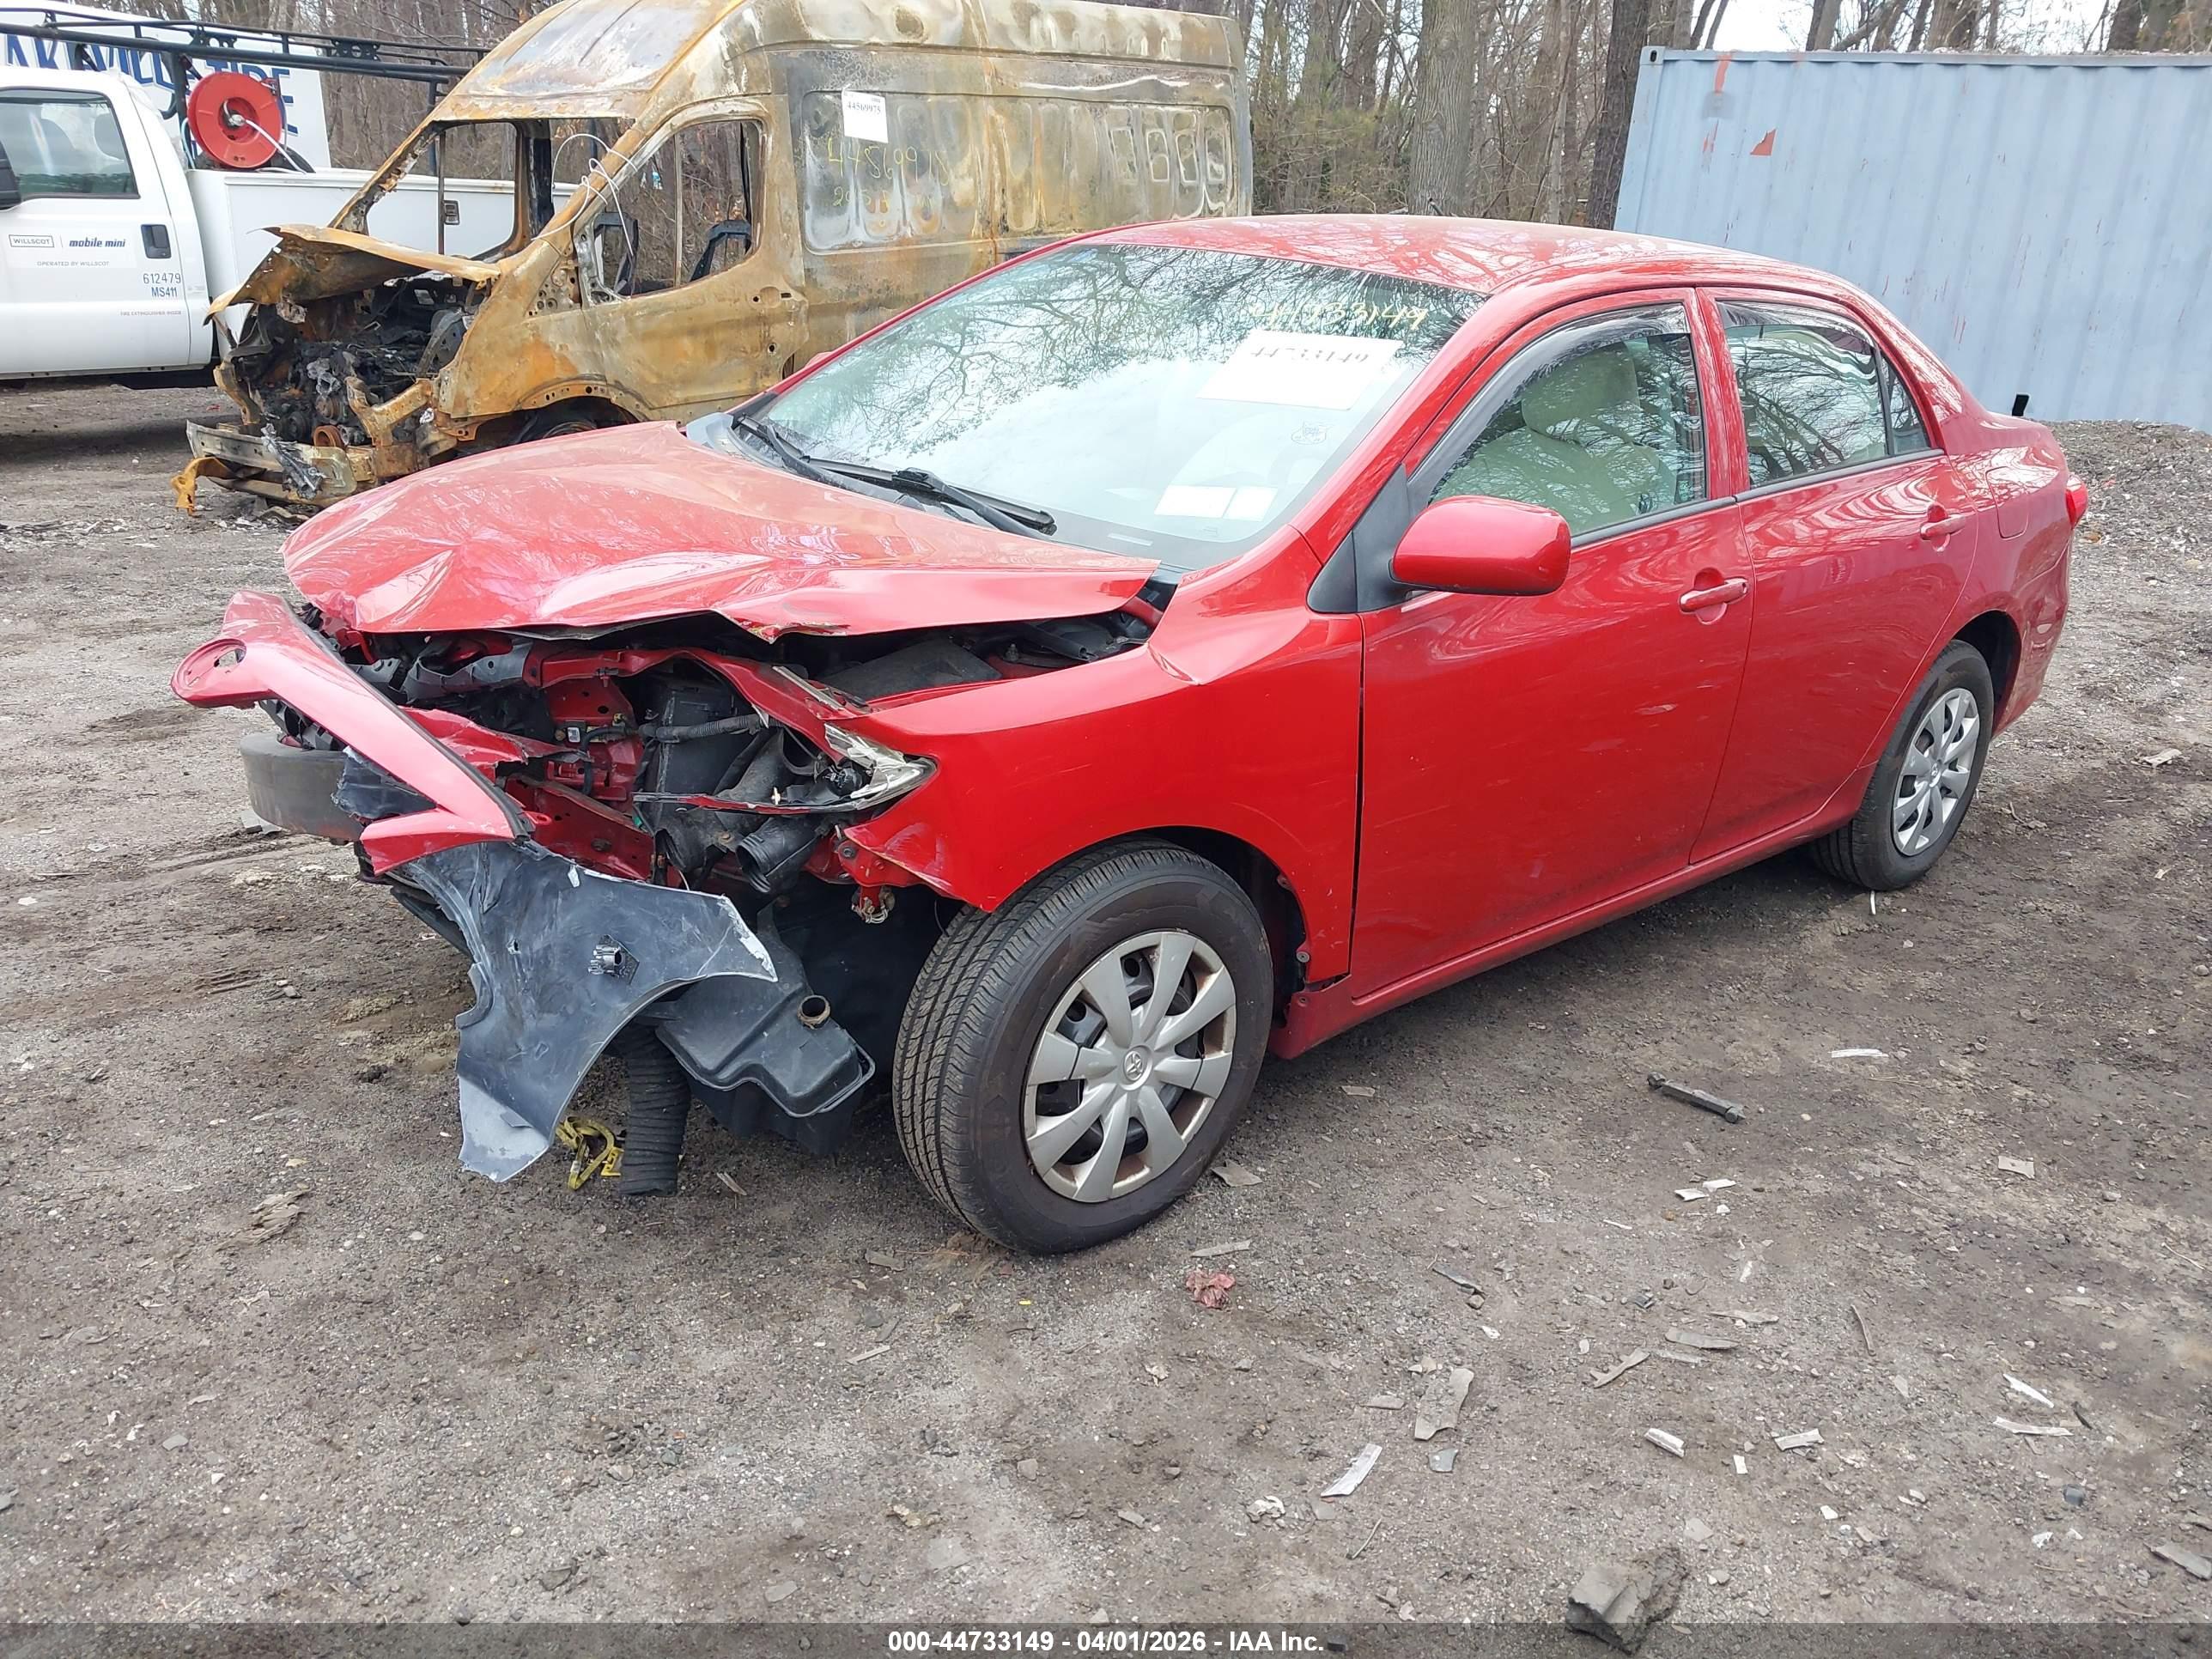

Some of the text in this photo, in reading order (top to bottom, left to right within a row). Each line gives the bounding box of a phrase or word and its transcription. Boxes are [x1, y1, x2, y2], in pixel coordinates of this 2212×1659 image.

[69, 237, 125, 247] mobile mini
[143, 272, 181, 284] 612479
[151, 287, 178, 297] MS411
